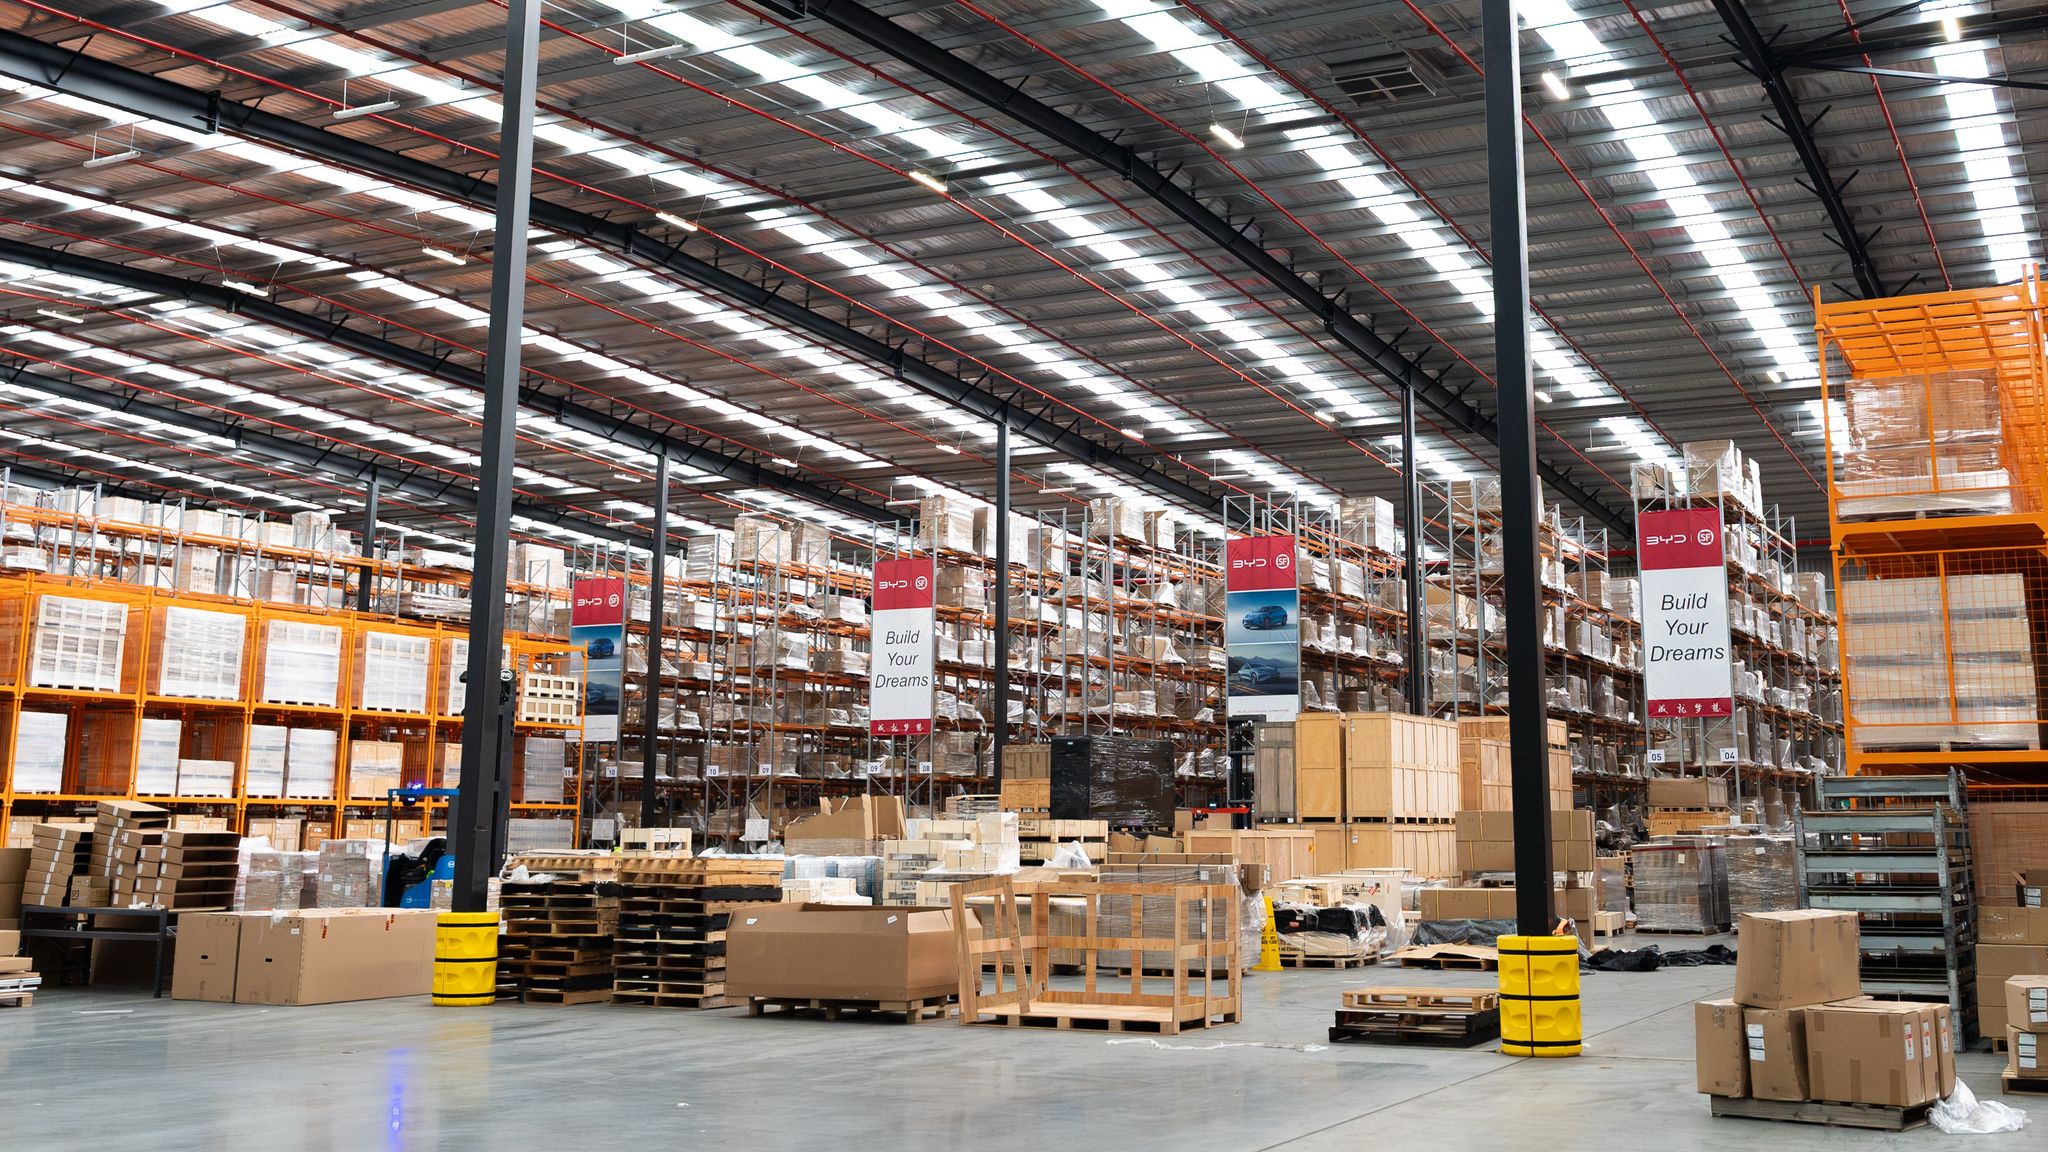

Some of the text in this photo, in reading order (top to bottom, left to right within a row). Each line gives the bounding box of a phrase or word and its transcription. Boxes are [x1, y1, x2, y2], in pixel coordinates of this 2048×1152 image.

[1646, 534, 1687, 546] BYD
[1232, 558, 1267, 569] BYD
[878, 580, 908, 590] BYD
[577, 597, 603, 607] BYD
[1661, 593, 1708, 611] Build
[1665, 619, 1709, 636] Your
[885, 630, 920, 645] Build
[887, 652, 919, 666] Your
[1650, 645, 1725, 662] Dreams
[875, 674, 929, 689] Dreams
[1651, 753, 1662, 761] 05
[1724, 752, 1736, 760] 04
